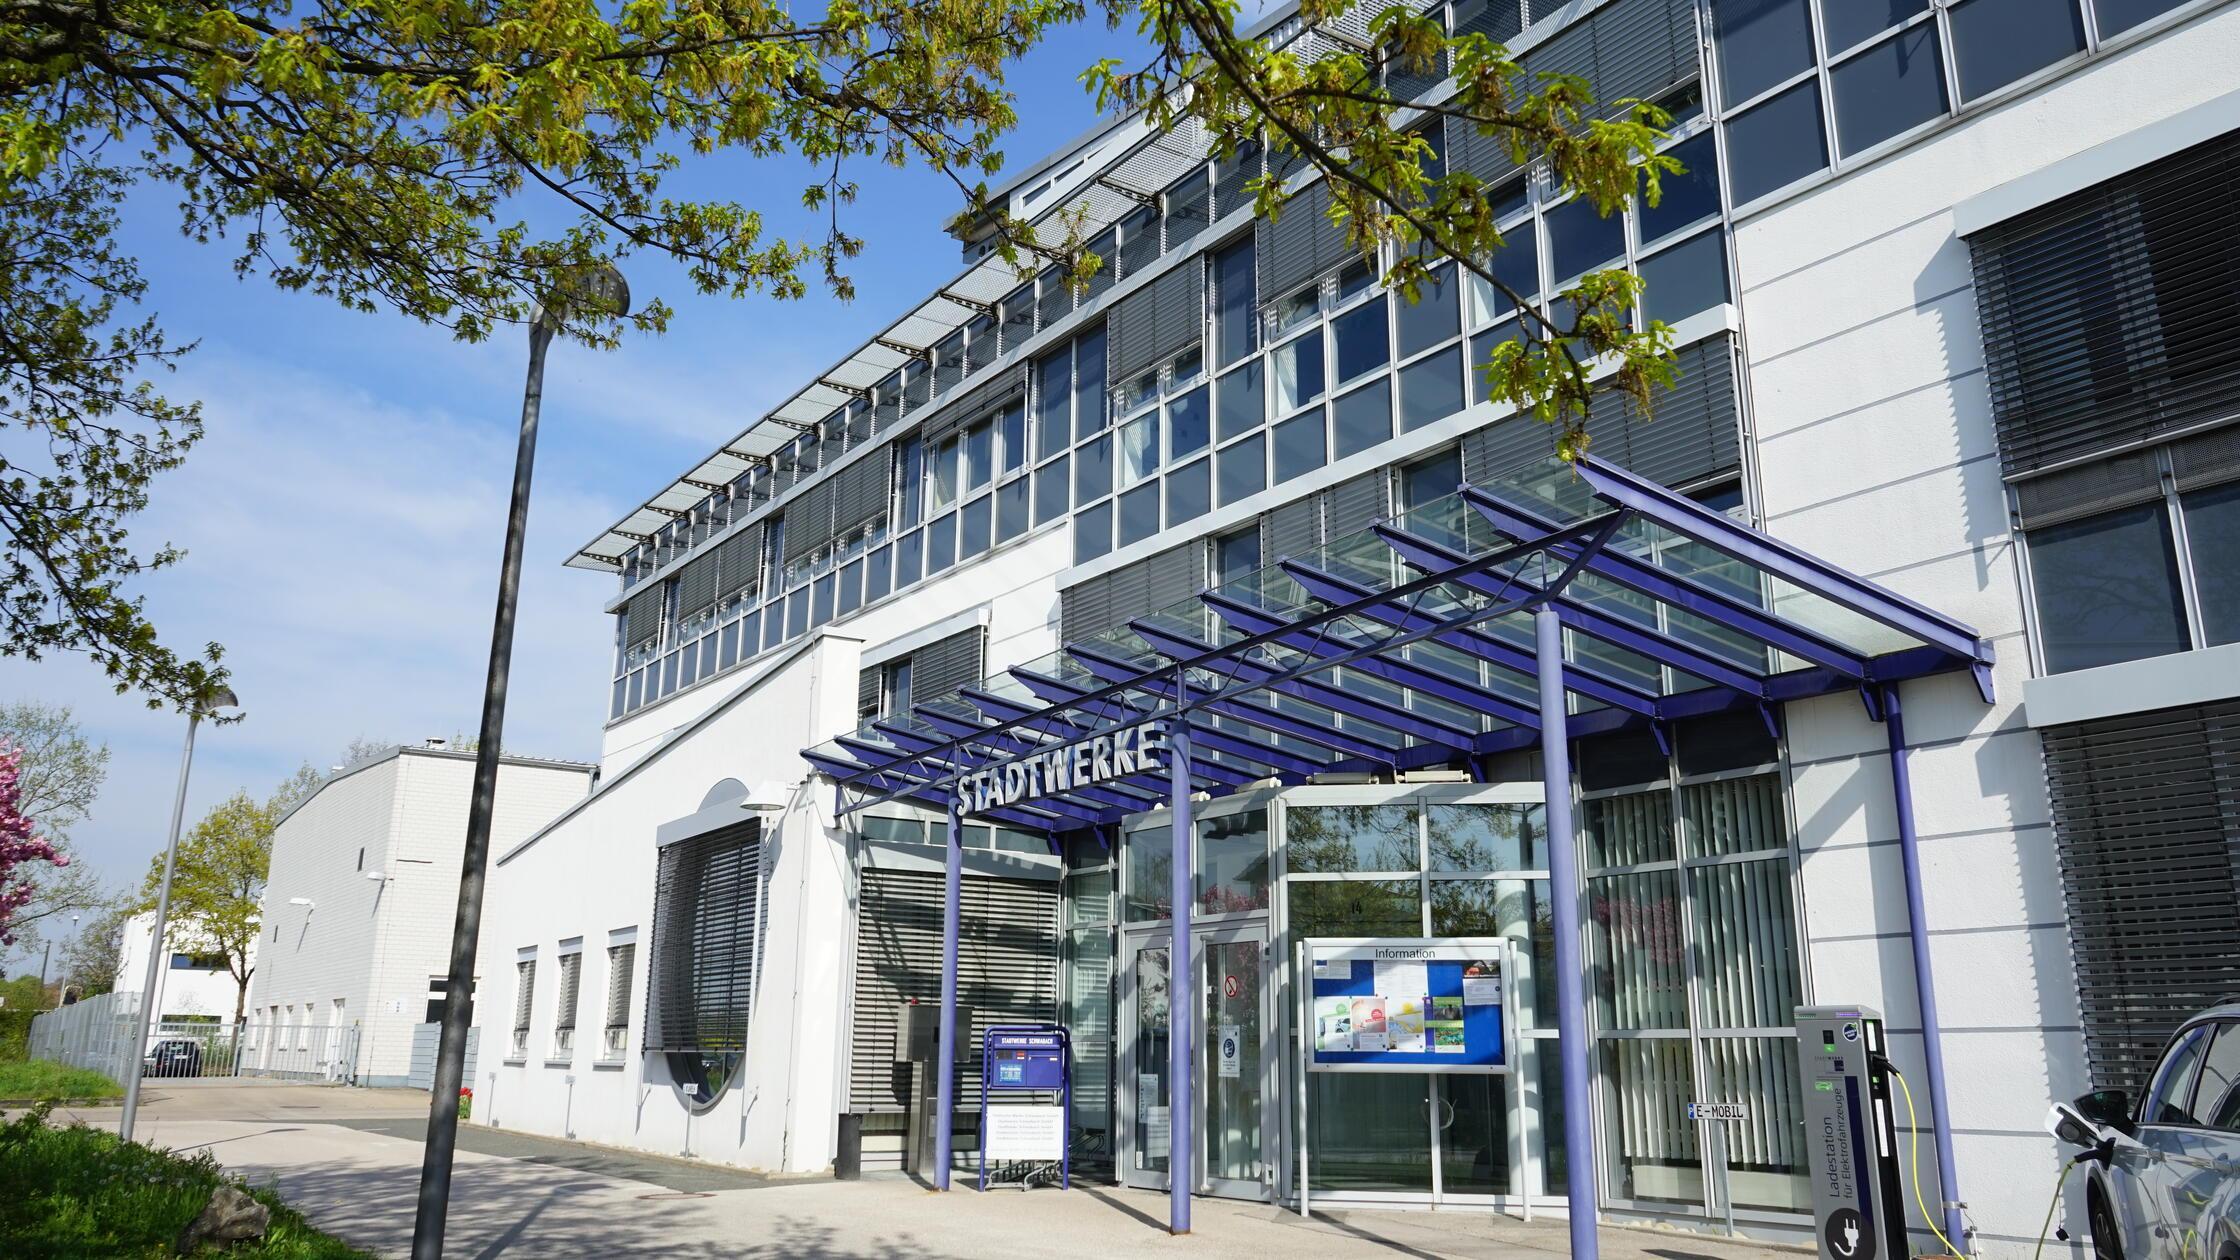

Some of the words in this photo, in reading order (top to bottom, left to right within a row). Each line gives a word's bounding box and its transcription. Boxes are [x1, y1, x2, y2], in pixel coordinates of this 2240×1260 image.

[957, 721, 1168, 817] STADTWERKE
[1375, 948, 1436, 959] Information
[1696, 1105, 1744, 1118] E-MOBIL
[1834, 1088, 1852, 1180] Elektrofahrzeuge
[1824, 1117, 1840, 1198] Ladestation
[1843, 1182, 1853, 1199] für
